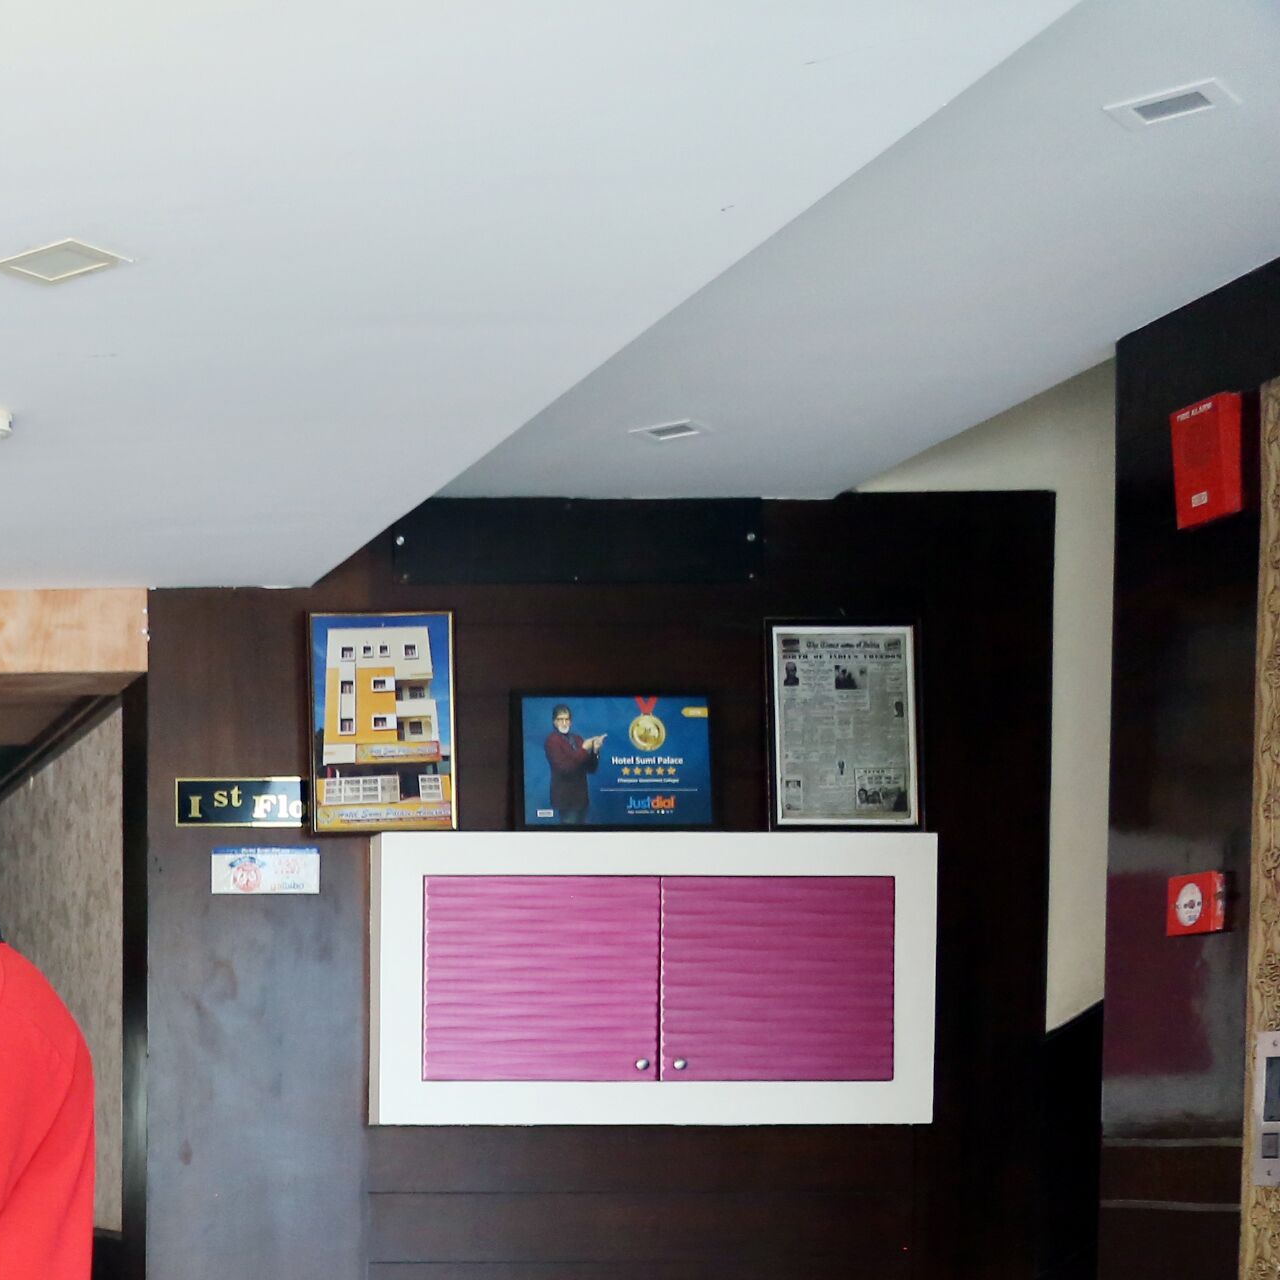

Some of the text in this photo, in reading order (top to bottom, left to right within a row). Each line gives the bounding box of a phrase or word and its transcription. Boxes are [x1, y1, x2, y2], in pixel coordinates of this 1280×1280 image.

[612, 756, 683, 765] Hotel Sumi Palace
